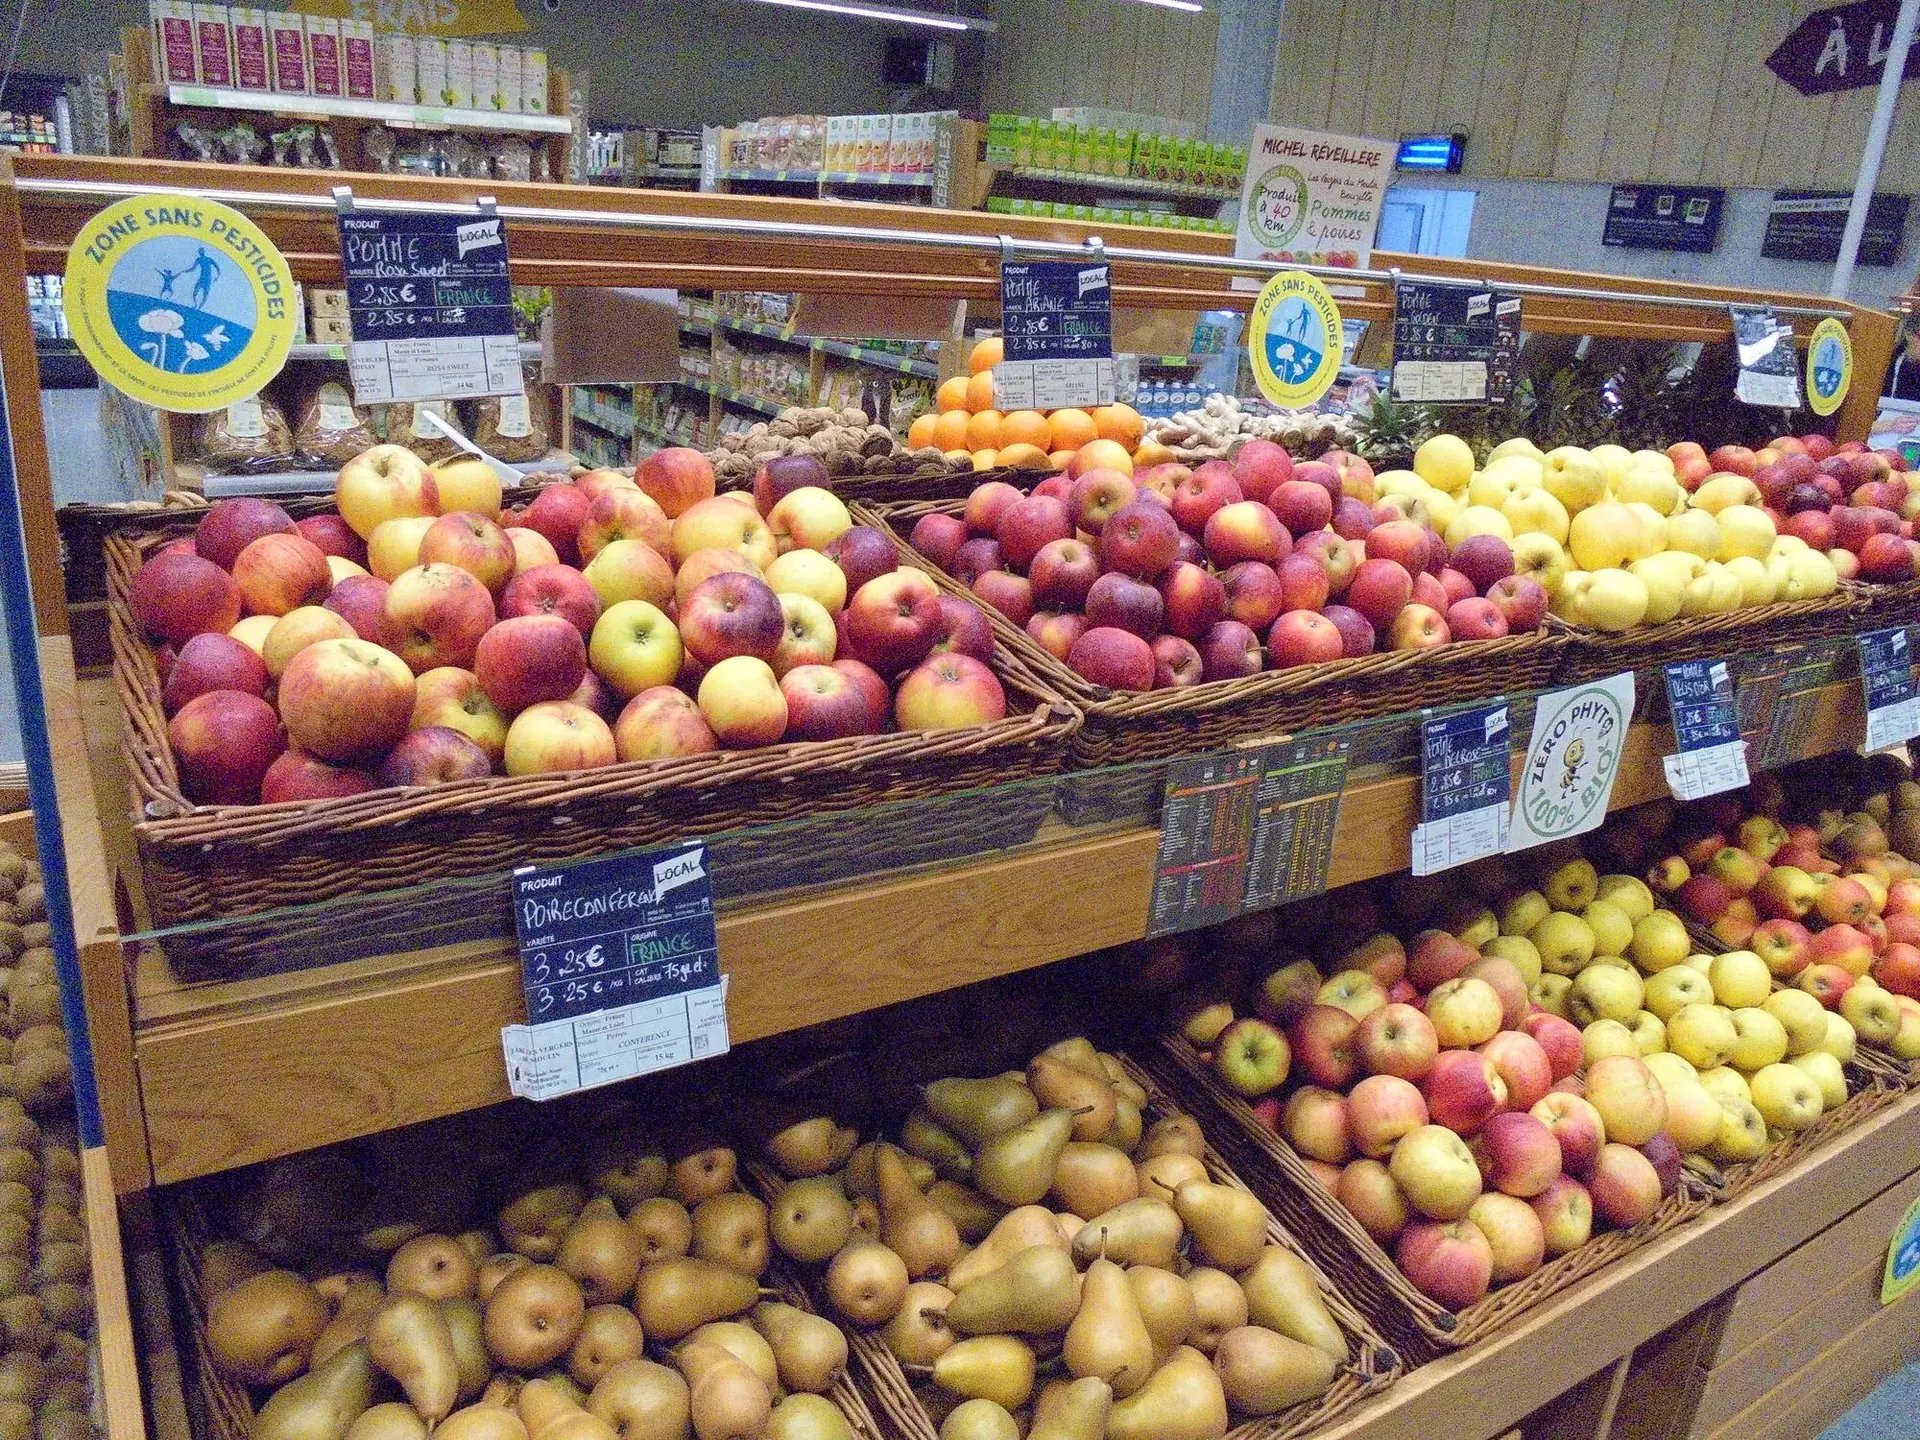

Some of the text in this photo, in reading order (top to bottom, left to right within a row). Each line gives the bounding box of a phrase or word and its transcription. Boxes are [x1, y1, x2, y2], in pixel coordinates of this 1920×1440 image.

[1815, 16, 1849, 76] À
[1263, 137, 1308, 158] MICHEL
[705, 144, 717, 186] SUCRES
[936, 129, 952, 208] CEREALES
[1260, 185, 1303, 204] Produit
[1260, 201, 1292, 219] à 40
[1310, 199, 1372, 223] Pommes
[344, 220, 381, 229] PRODUIT
[1264, 216, 1285, 232] km
[459, 228, 497, 242] LOCAL
[1306, 221, 1362, 249] & poires
[346, 234, 420, 263] POMME
[85, 207, 286, 320] ZONE SANS PESTICIDES
[375, 261, 408, 278] Rosa
[411, 259, 452, 278] Sweet
[1005, 266, 1029, 275] PRODUIT
[1006, 279, 1041, 298] POMME
[1080, 274, 1104, 285] LOCAL
[438, 288, 494, 306] FRANCE
[1025, 294, 1065, 314] ARIANE
[1259, 279, 1338, 349] ZONE SANS PESTICIDES
[1063, 320, 1101, 336] FRANCE
[1532, 719, 1567, 785] ZÉRO
[1529, 788, 1575, 828] 100%
[656, 859, 700, 884] LOCAL
[520, 874, 564, 893] PRODUIT
[526, 934, 555, 947] VARIÉTÉ
[630, 932, 696, 964] FRANCE
[635, 968, 648, 976] CAT
[592, 980, 604, 994] €
[538, 1042, 573, 1054] VERGERS
[618, 1030, 672, 1049] CONFERENCE
[530, 1052, 560, 1063] MOULIN
[655, 1053, 663, 1061] 15
[664, 1052, 674, 1061] kg
